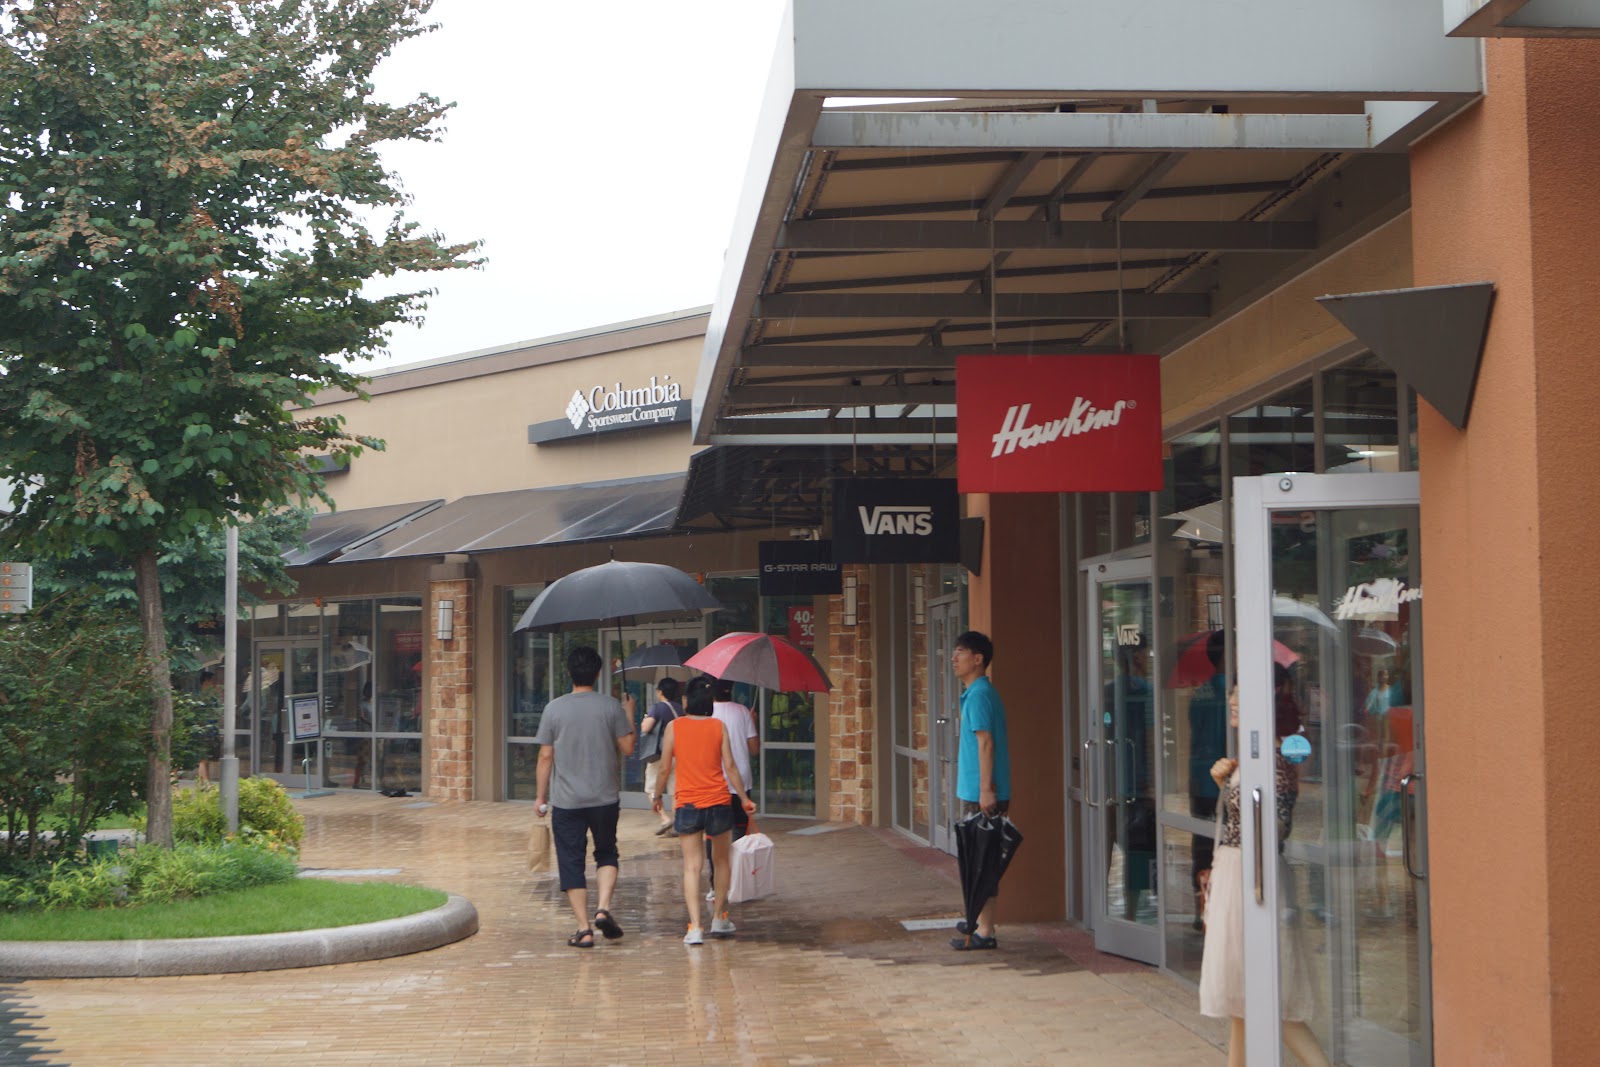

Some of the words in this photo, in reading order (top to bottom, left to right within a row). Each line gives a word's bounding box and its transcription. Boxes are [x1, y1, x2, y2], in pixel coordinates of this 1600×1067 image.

[588, 374, 681, 414] Columbia
[587, 411, 633, 431] Sportswear
[632, 405, 678, 422] Company
[858, 505, 934, 536] VANS
[764, 563, 807, 572] G-STAR
[810, 563, 837, 571] RAW
[1116, 623, 1141, 646] VANS
